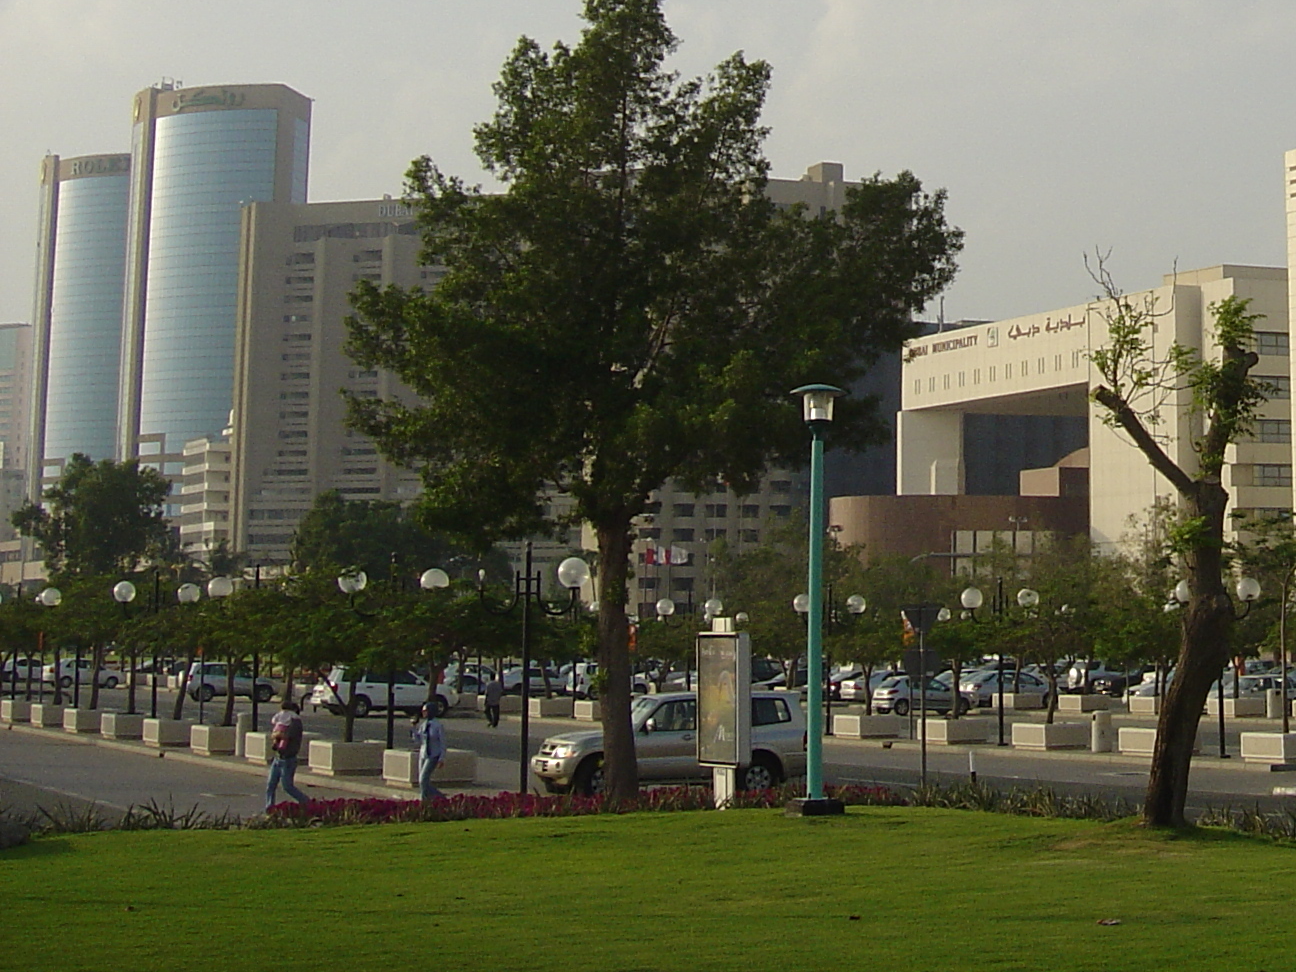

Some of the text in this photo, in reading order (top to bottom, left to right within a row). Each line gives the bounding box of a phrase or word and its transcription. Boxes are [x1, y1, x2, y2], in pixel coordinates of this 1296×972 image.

[1008, 313, 1086, 341] بلدية دبي
[932, 334, 978, 354] MUNICIPALITY
